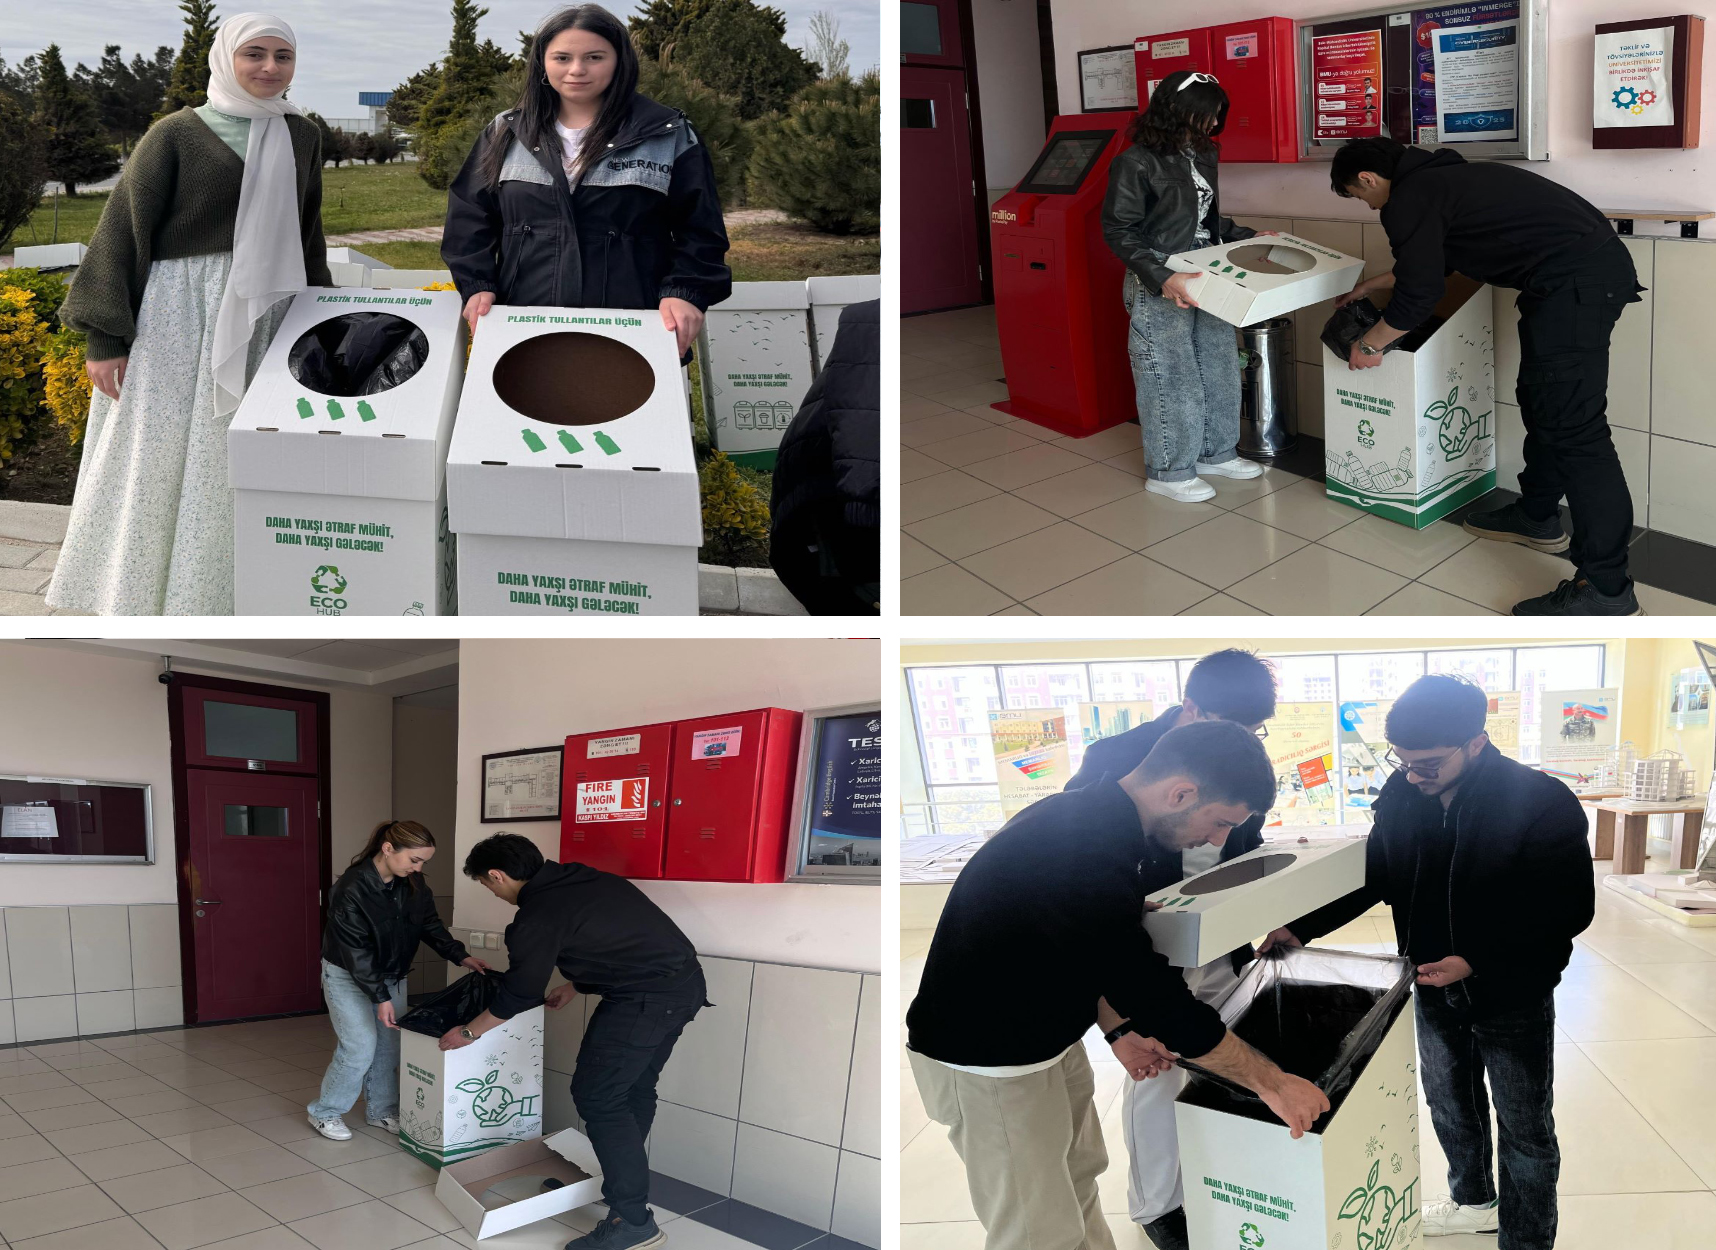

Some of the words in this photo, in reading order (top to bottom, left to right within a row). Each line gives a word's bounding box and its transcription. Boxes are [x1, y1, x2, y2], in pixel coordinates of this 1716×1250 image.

[1445, 16, 1471, 25] SONSUZ
[992, 210, 1016, 221] million
[353, 296, 407, 304] TULLANTILAR
[409, 297, 432, 307] ÜÇÜN
[508, 315, 546, 323] PLASTİK
[549, 317, 612, 325] TULLANTILAR
[615, 317, 642, 327] ÜÇÜN
[1358, 436, 1375, 446] ECO
[266, 517, 292, 529] DAHA
[294, 519, 322, 534] YAXŞI
[326, 521, 356, 534] ƏTRAF
[359, 523, 394, 539] MÜHİT,
[276, 533, 302, 545] DAHA
[305, 535, 333, 550] YAXŞI
[336, 538, 384, 552] GƏLƏCƏK!
[498, 572, 529, 586] DAHA
[532, 575, 566, 593] YAXŞI
[569, 579, 606, 593] ƏTRAF
[609, 581, 652, 599] MÜHİT,
[310, 596, 347, 609] ECO
[510, 591, 541, 605] DAHA
[544, 594, 578, 612] YAXŞI
[582, 597, 639, 614] GƏLƏCƏK!
[316, 608, 340, 616] HUB
[586, 781, 612, 793] FIRE
[582, 795, 616, 805] YANGIN
[1204, 1176, 1222, 1189] DAHA
[1224, 1182, 1244, 1197] YAXŞI
[1246, 1189, 1268, 1202] ƏTRAF
[1212, 1190, 1230, 1203] DAHA
[1232, 1196, 1252, 1212] YAXŞI
[1254, 1203, 1289, 1222] GƏLƏCƏK!
